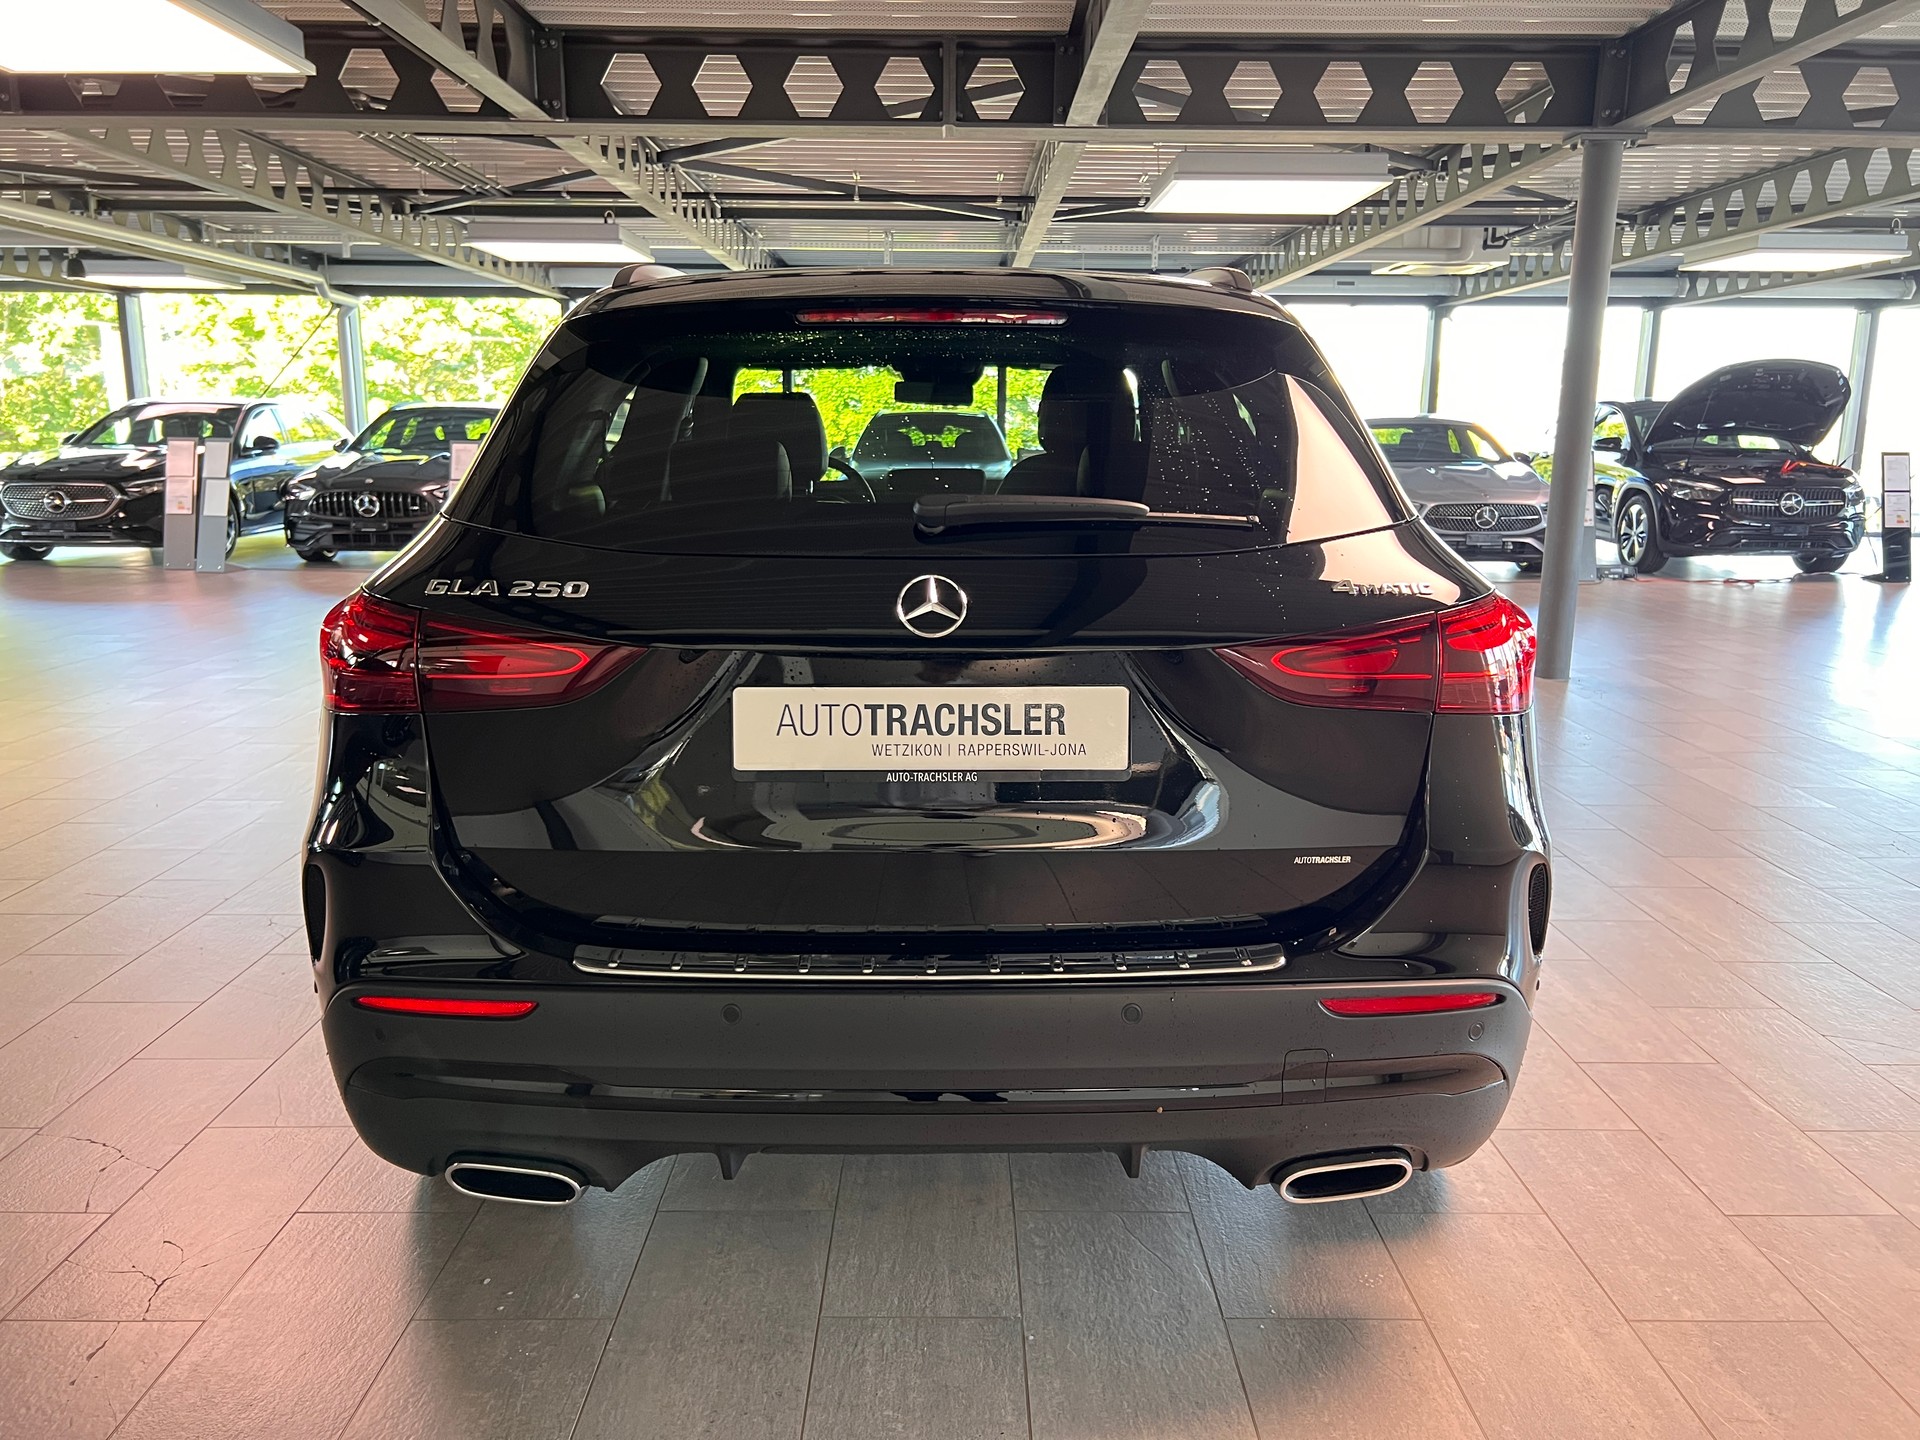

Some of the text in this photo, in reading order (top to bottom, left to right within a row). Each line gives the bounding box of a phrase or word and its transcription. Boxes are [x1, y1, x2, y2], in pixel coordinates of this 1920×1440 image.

[425, 578, 590, 598] GLA 250
[1331, 578, 1434, 596] 4MATIC
[776, 703, 1066, 737] AUTOTRACHSLER
[871, 743, 1087, 757] WETZIKON RAPPERSWIL-JONA
[886, 772, 978, 783] AUTO-TRACHSLER AG
[1293, 855, 1352, 865] AUTOTRACHSLER
